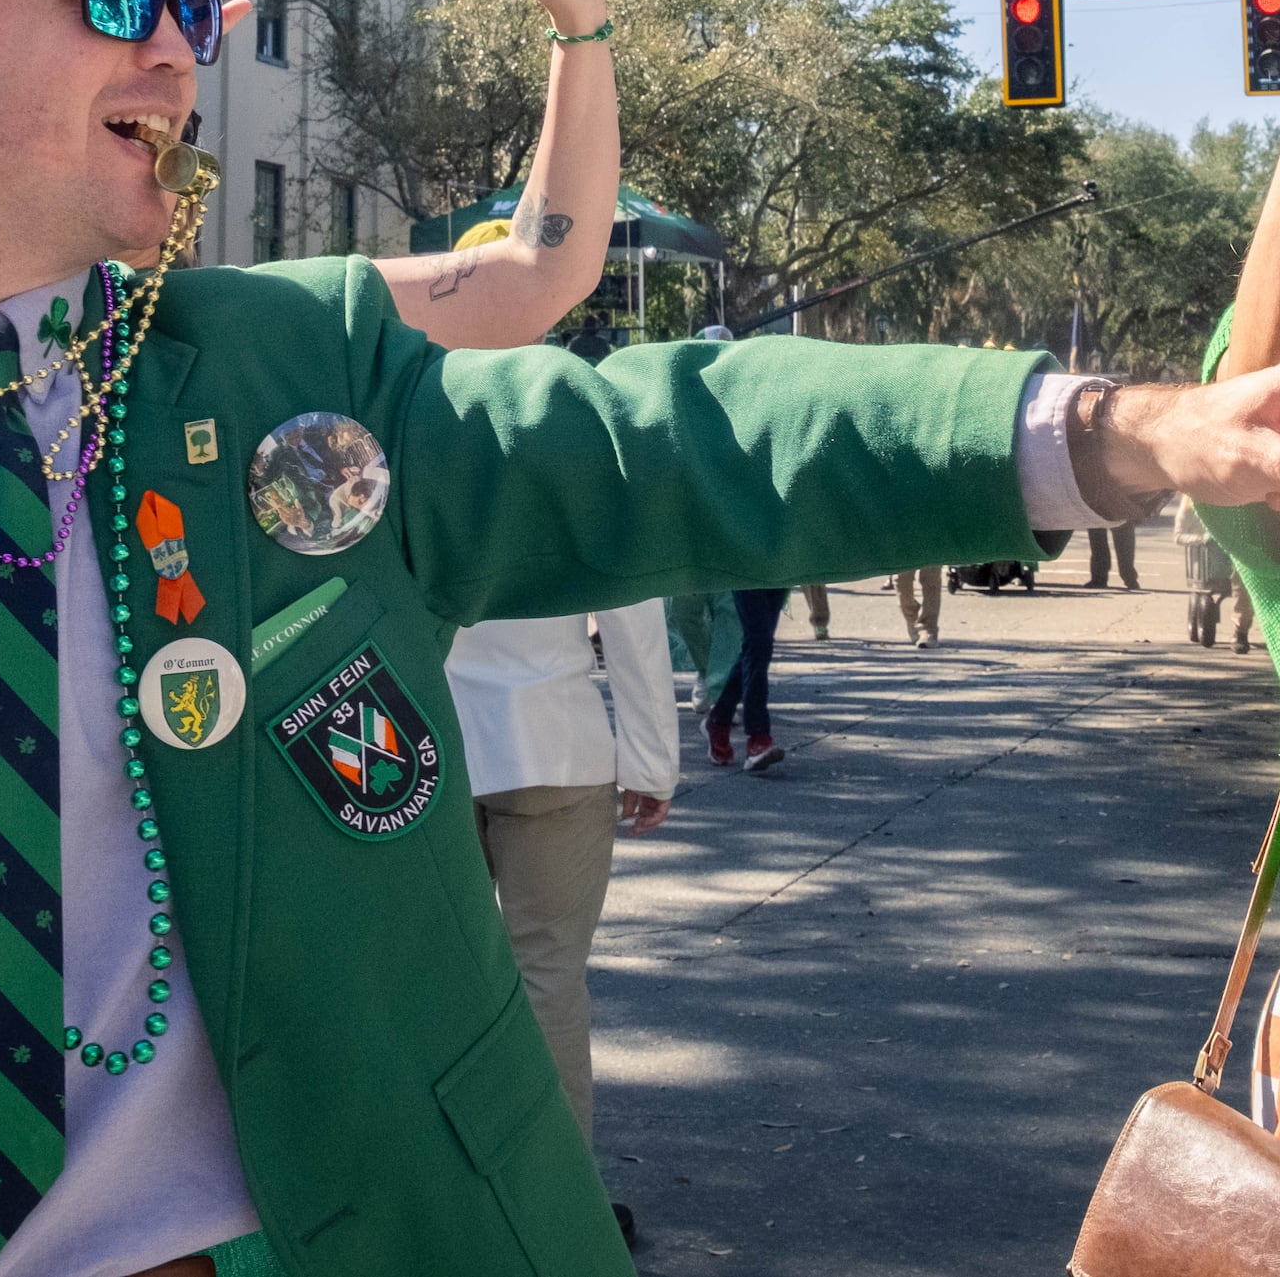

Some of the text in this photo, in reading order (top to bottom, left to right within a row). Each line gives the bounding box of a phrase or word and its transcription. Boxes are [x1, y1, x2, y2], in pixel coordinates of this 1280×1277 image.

[262, 604, 329, 652] O'CONNOR
[163, 658, 215, 670] O'Connor
[282, 654, 371, 735] SINN FEIN
[332, 701, 355, 725] 33
[340, 735, 439, 834] SAVANNAH, GA
